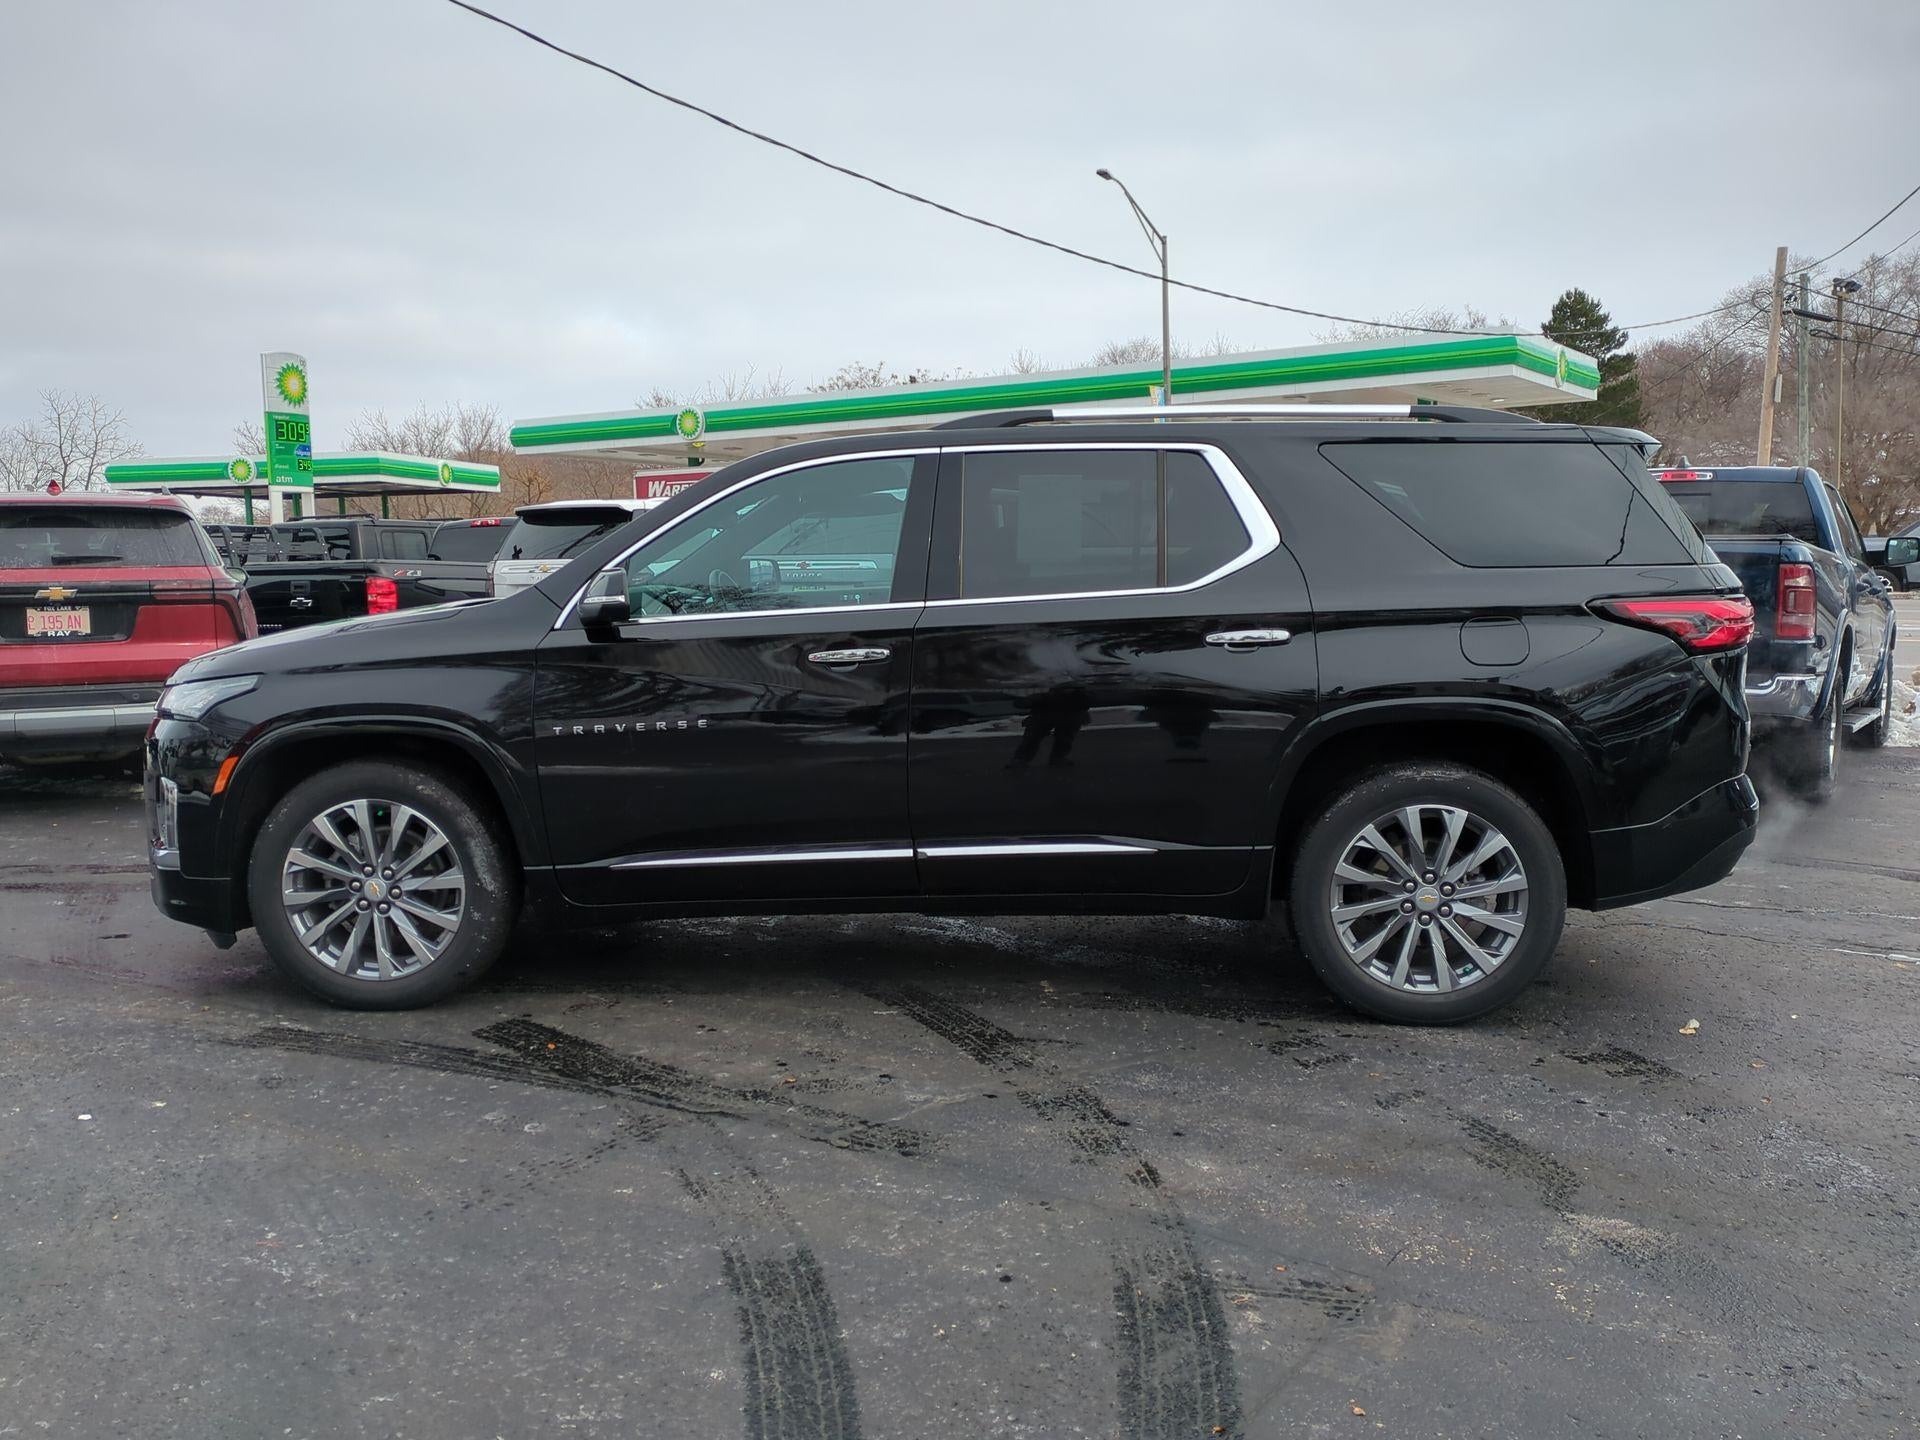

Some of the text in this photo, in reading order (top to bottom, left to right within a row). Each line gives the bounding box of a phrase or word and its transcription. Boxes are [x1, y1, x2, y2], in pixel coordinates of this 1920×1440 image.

[276, 475, 293, 483] atm
[40, 615, 63, 630] 195
[67, 615, 81, 629] AN
[552, 718, 709, 736] TRAVERSE
